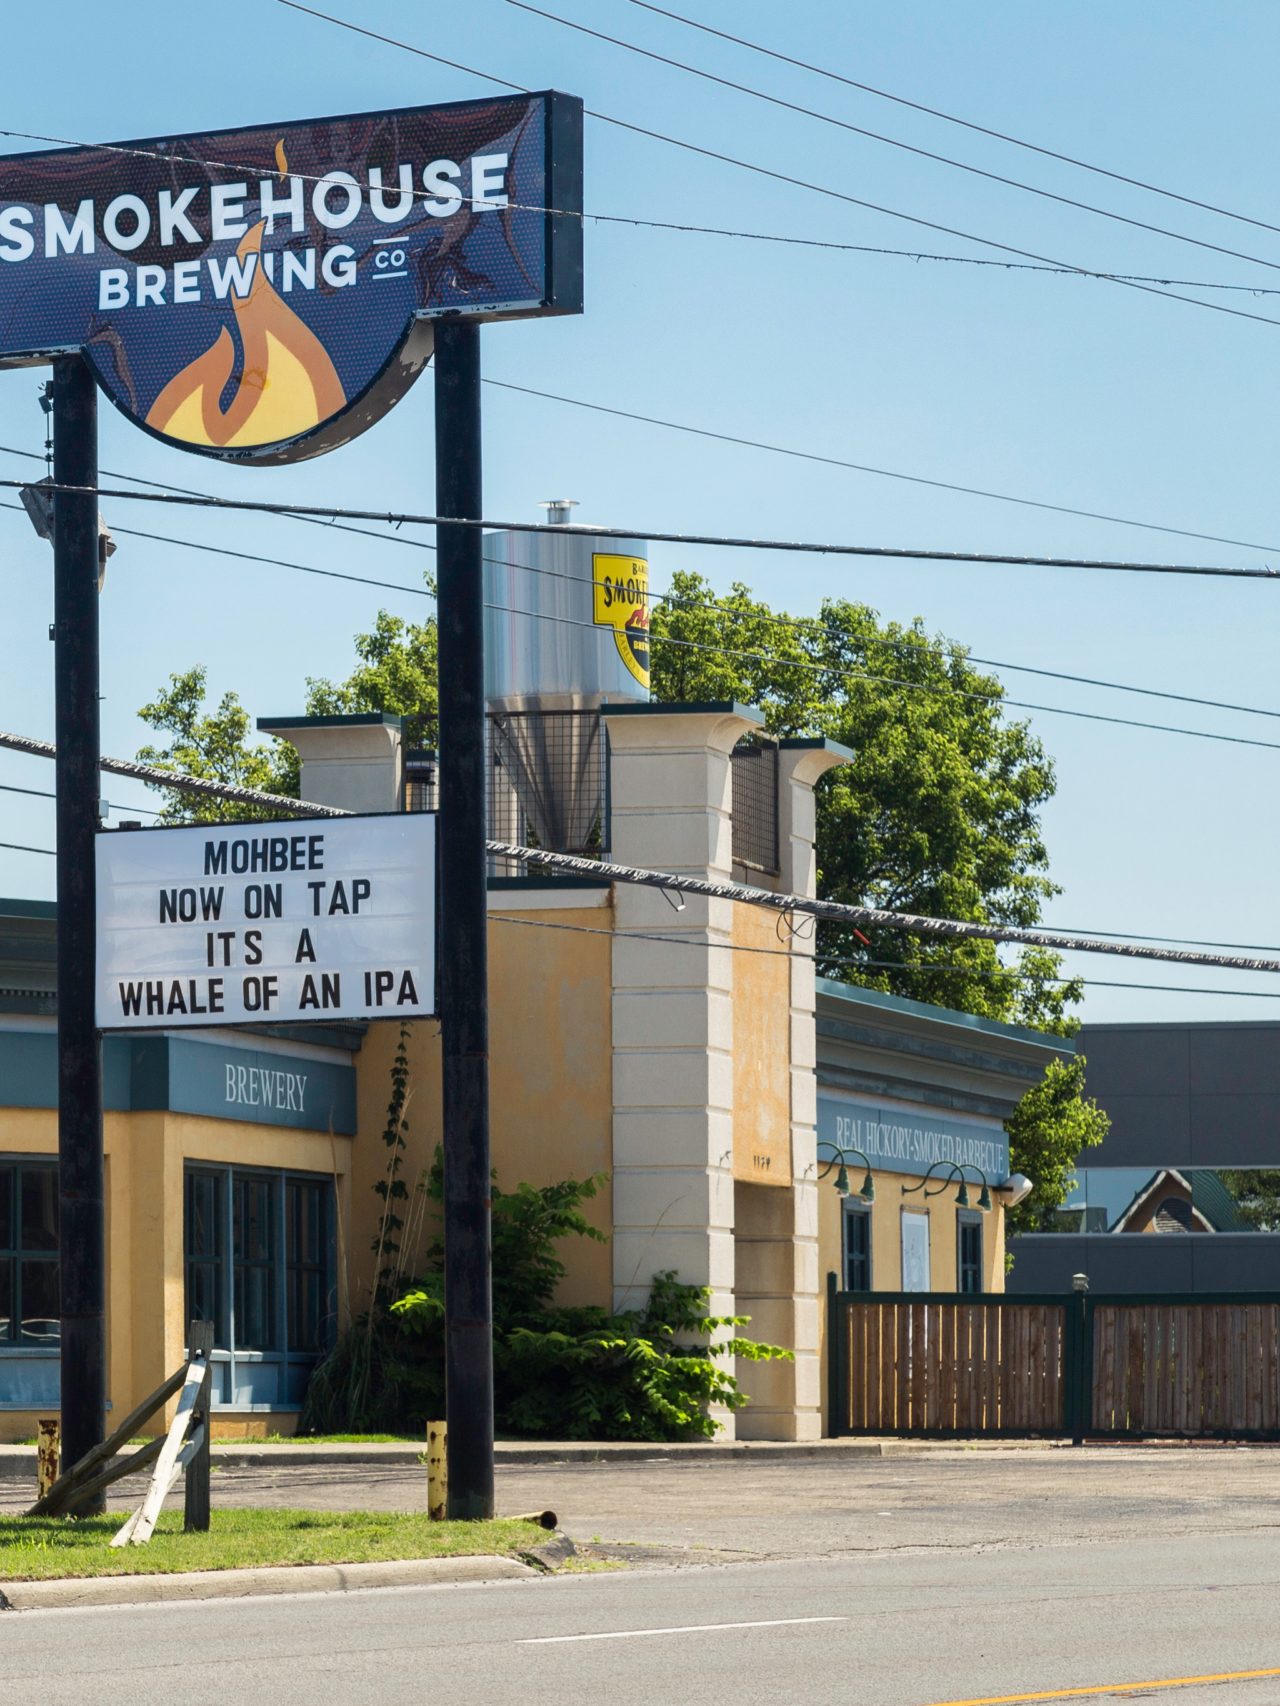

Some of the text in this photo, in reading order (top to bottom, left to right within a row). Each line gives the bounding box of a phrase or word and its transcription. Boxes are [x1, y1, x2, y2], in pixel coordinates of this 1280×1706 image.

[98, 244, 406, 311] BREWING CO
[204, 835, 324, 876] MOHBEE
[160, 879, 370, 923] NOW ON TAP
[207, 928, 316, 967] ITS A
[119, 970, 419, 1016] WHALE OF AN IPA
[225, 1063, 307, 1112] BREWERY
[836, 1116, 1004, 1174] REAL HICKORY-SMOKED BARBECUE
